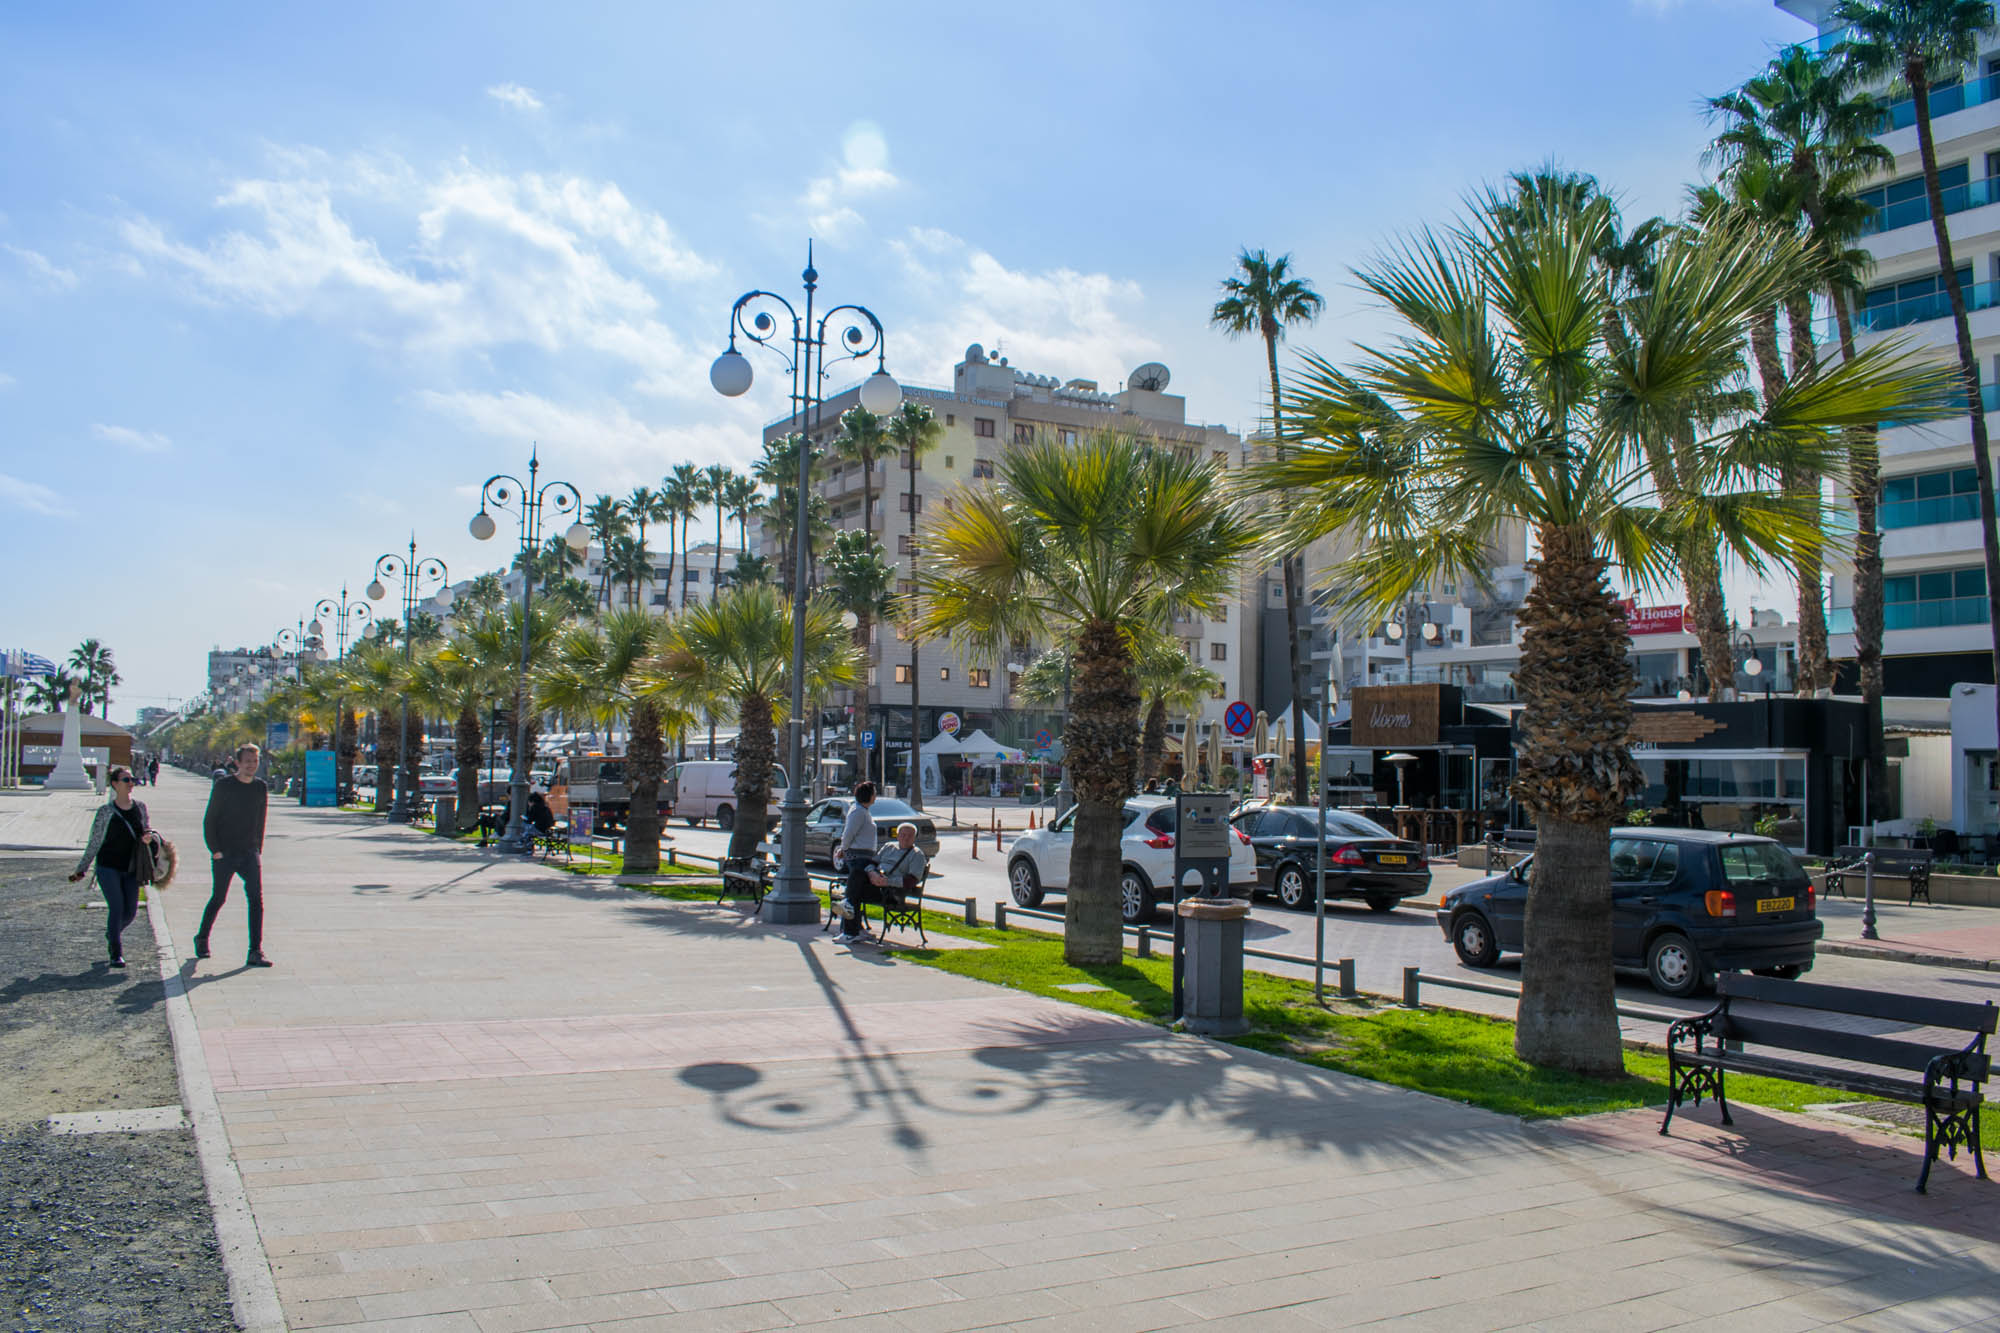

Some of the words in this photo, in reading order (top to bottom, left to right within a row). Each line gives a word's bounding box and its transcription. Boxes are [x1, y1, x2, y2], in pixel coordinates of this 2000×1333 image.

[1641, 608, 1681, 620] House
[1370, 704, 1412, 728] blooms
[942, 722, 958, 730] KING
[864, 732, 872, 743] P
